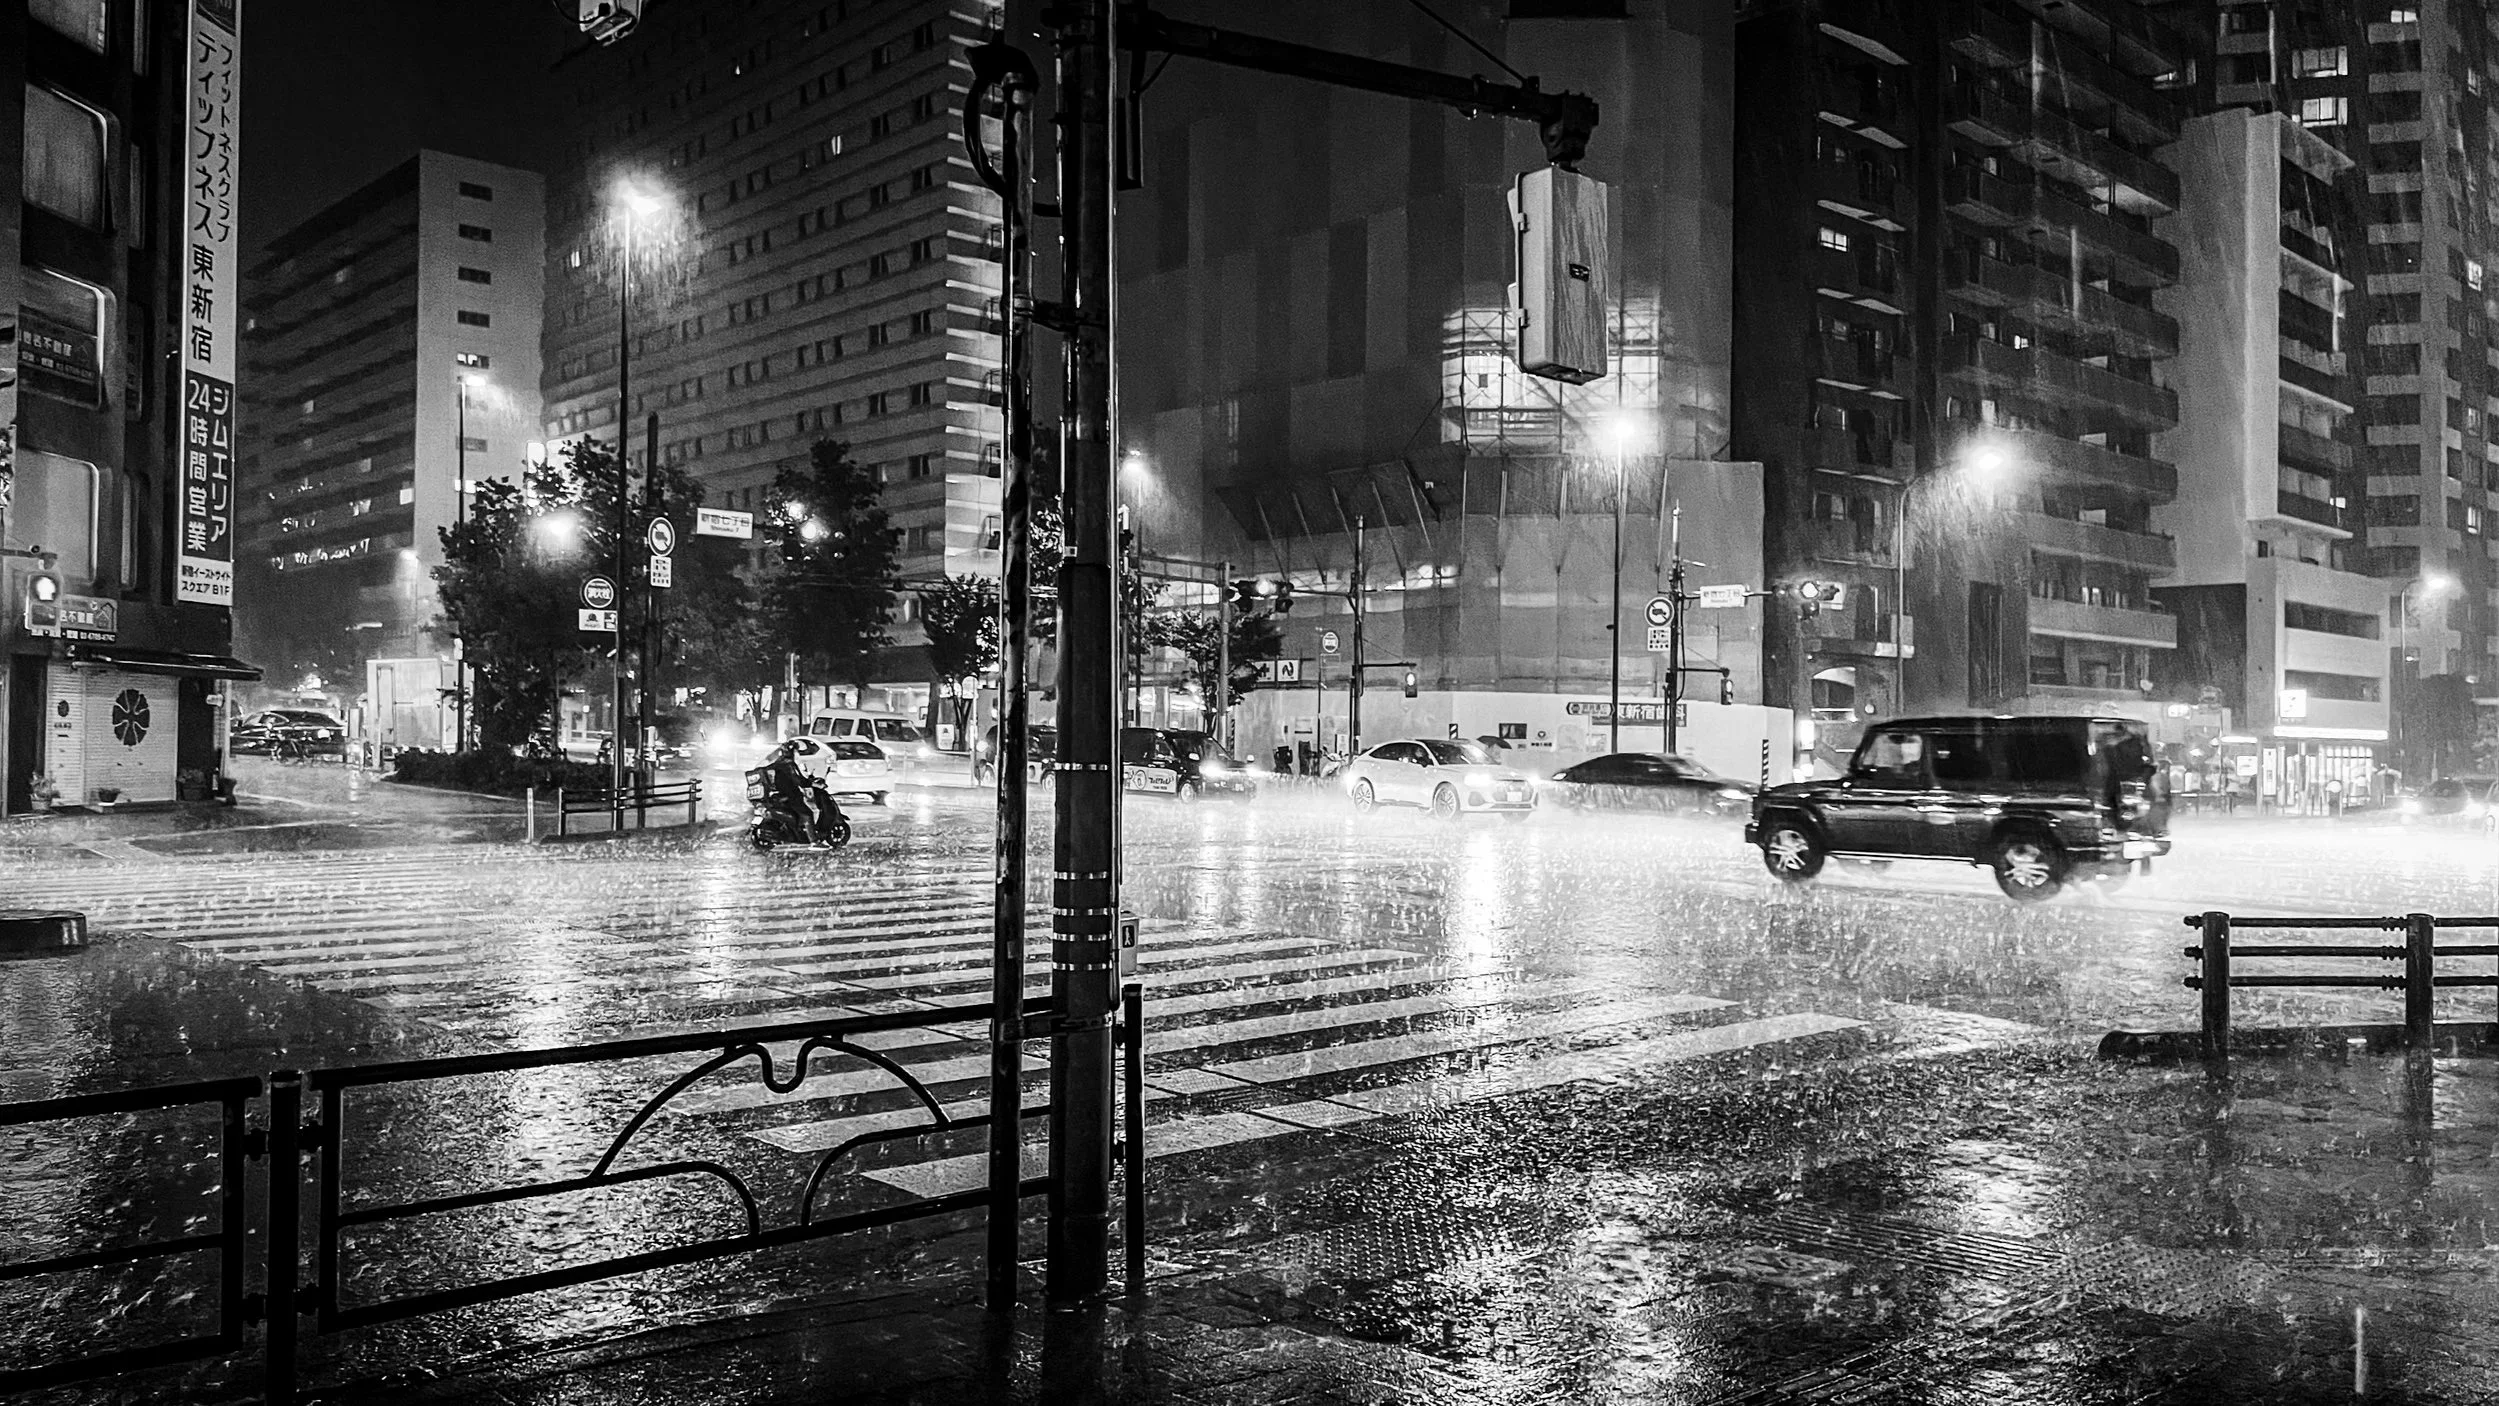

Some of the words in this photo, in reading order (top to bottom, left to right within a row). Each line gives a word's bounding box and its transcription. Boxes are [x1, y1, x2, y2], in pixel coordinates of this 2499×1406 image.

[191, 31, 217, 364] ティップネス東新宿
[216, 44, 232, 243] フィットネスクラブ
[187, 379, 211, 552] 24時間営業
[211, 386, 230, 543] ジムエリア
[181, 580, 210, 593] スクエア
[212, 584, 230, 596] B1F
